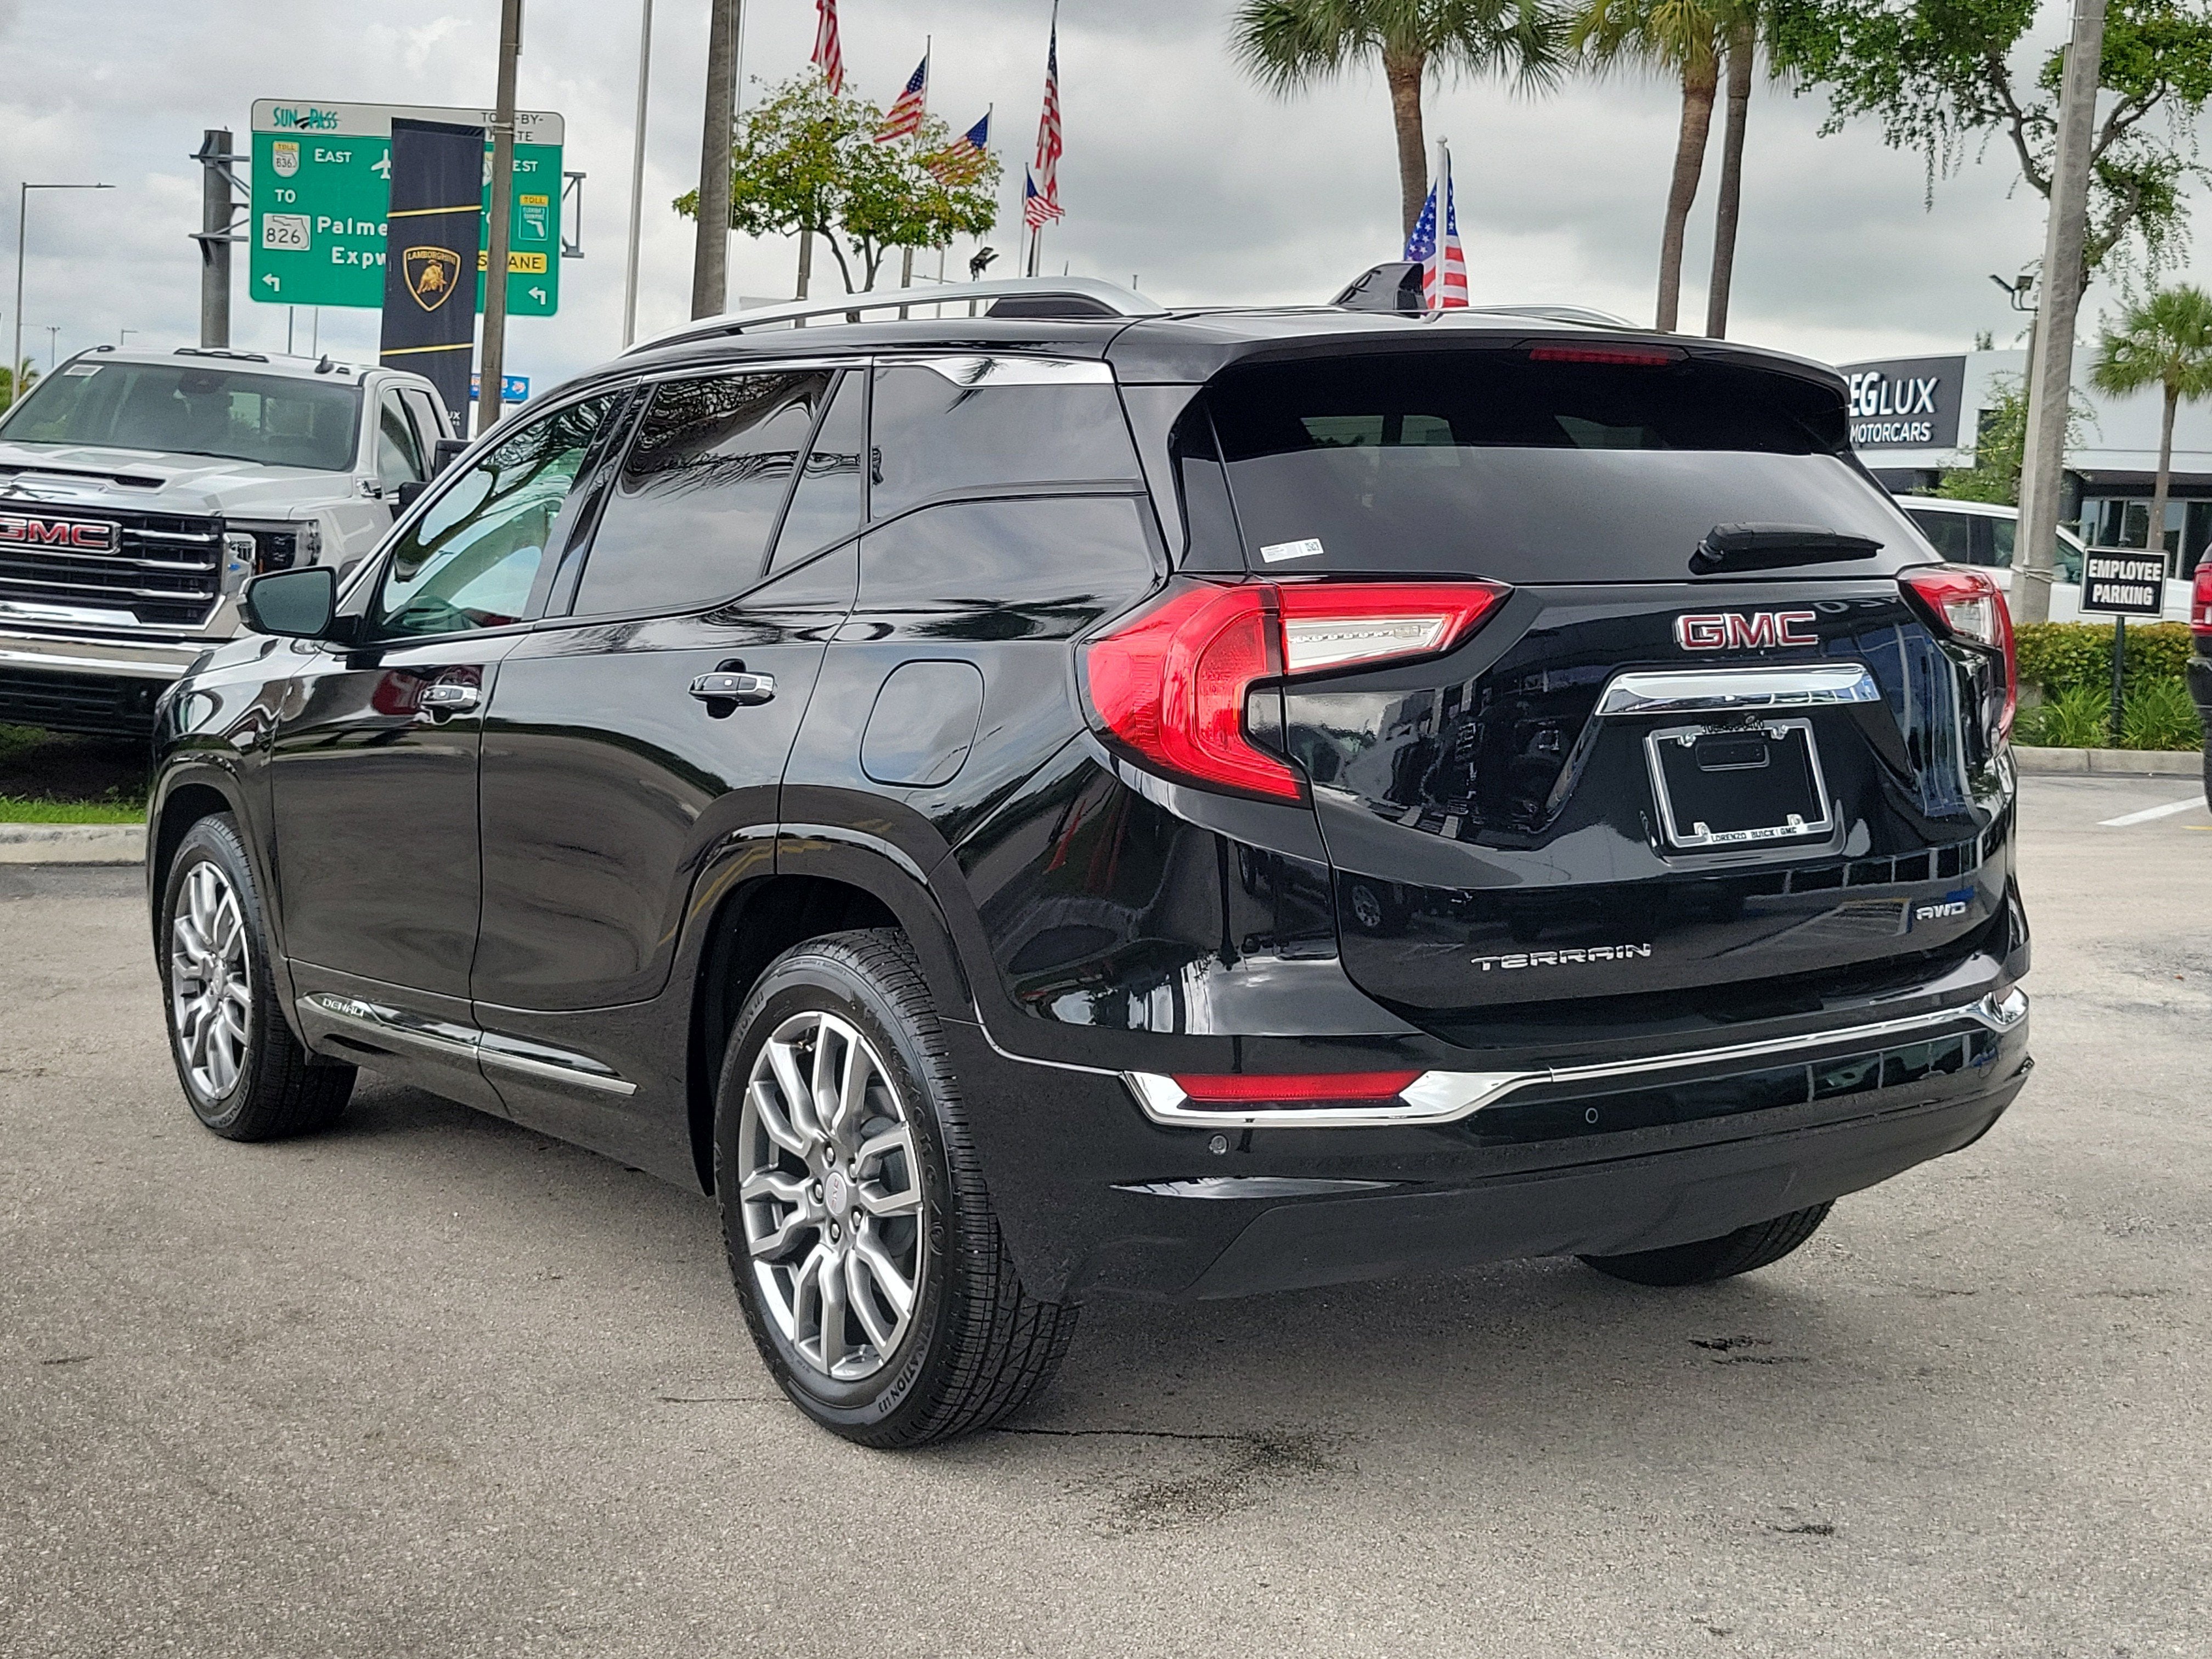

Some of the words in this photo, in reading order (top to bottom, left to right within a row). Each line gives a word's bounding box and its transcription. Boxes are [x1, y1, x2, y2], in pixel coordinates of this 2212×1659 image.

[276, 157, 292, 168] 836
[314, 148, 352, 162] EAST
[513, 160, 538, 172] EST
[275, 189, 296, 203] TO
[267, 227, 301, 244] 826
[509, 256, 541, 269] ANE
[1849, 421, 1933, 443] MOTORCARS
[2089, 558, 2162, 582] EMPLOYEE
[2092, 583, 2154, 606] PARKING
[1676, 611, 1819, 650] GMC
[1711, 832, 1747, 843] LORENZO
[1751, 829, 1774, 839] BUICK
[1780, 826, 1797, 835] GMC
[1916, 901, 1966, 920] AWD
[1471, 943, 1651, 971] TERRAIN
[322, 997, 364, 1017] DENALI
